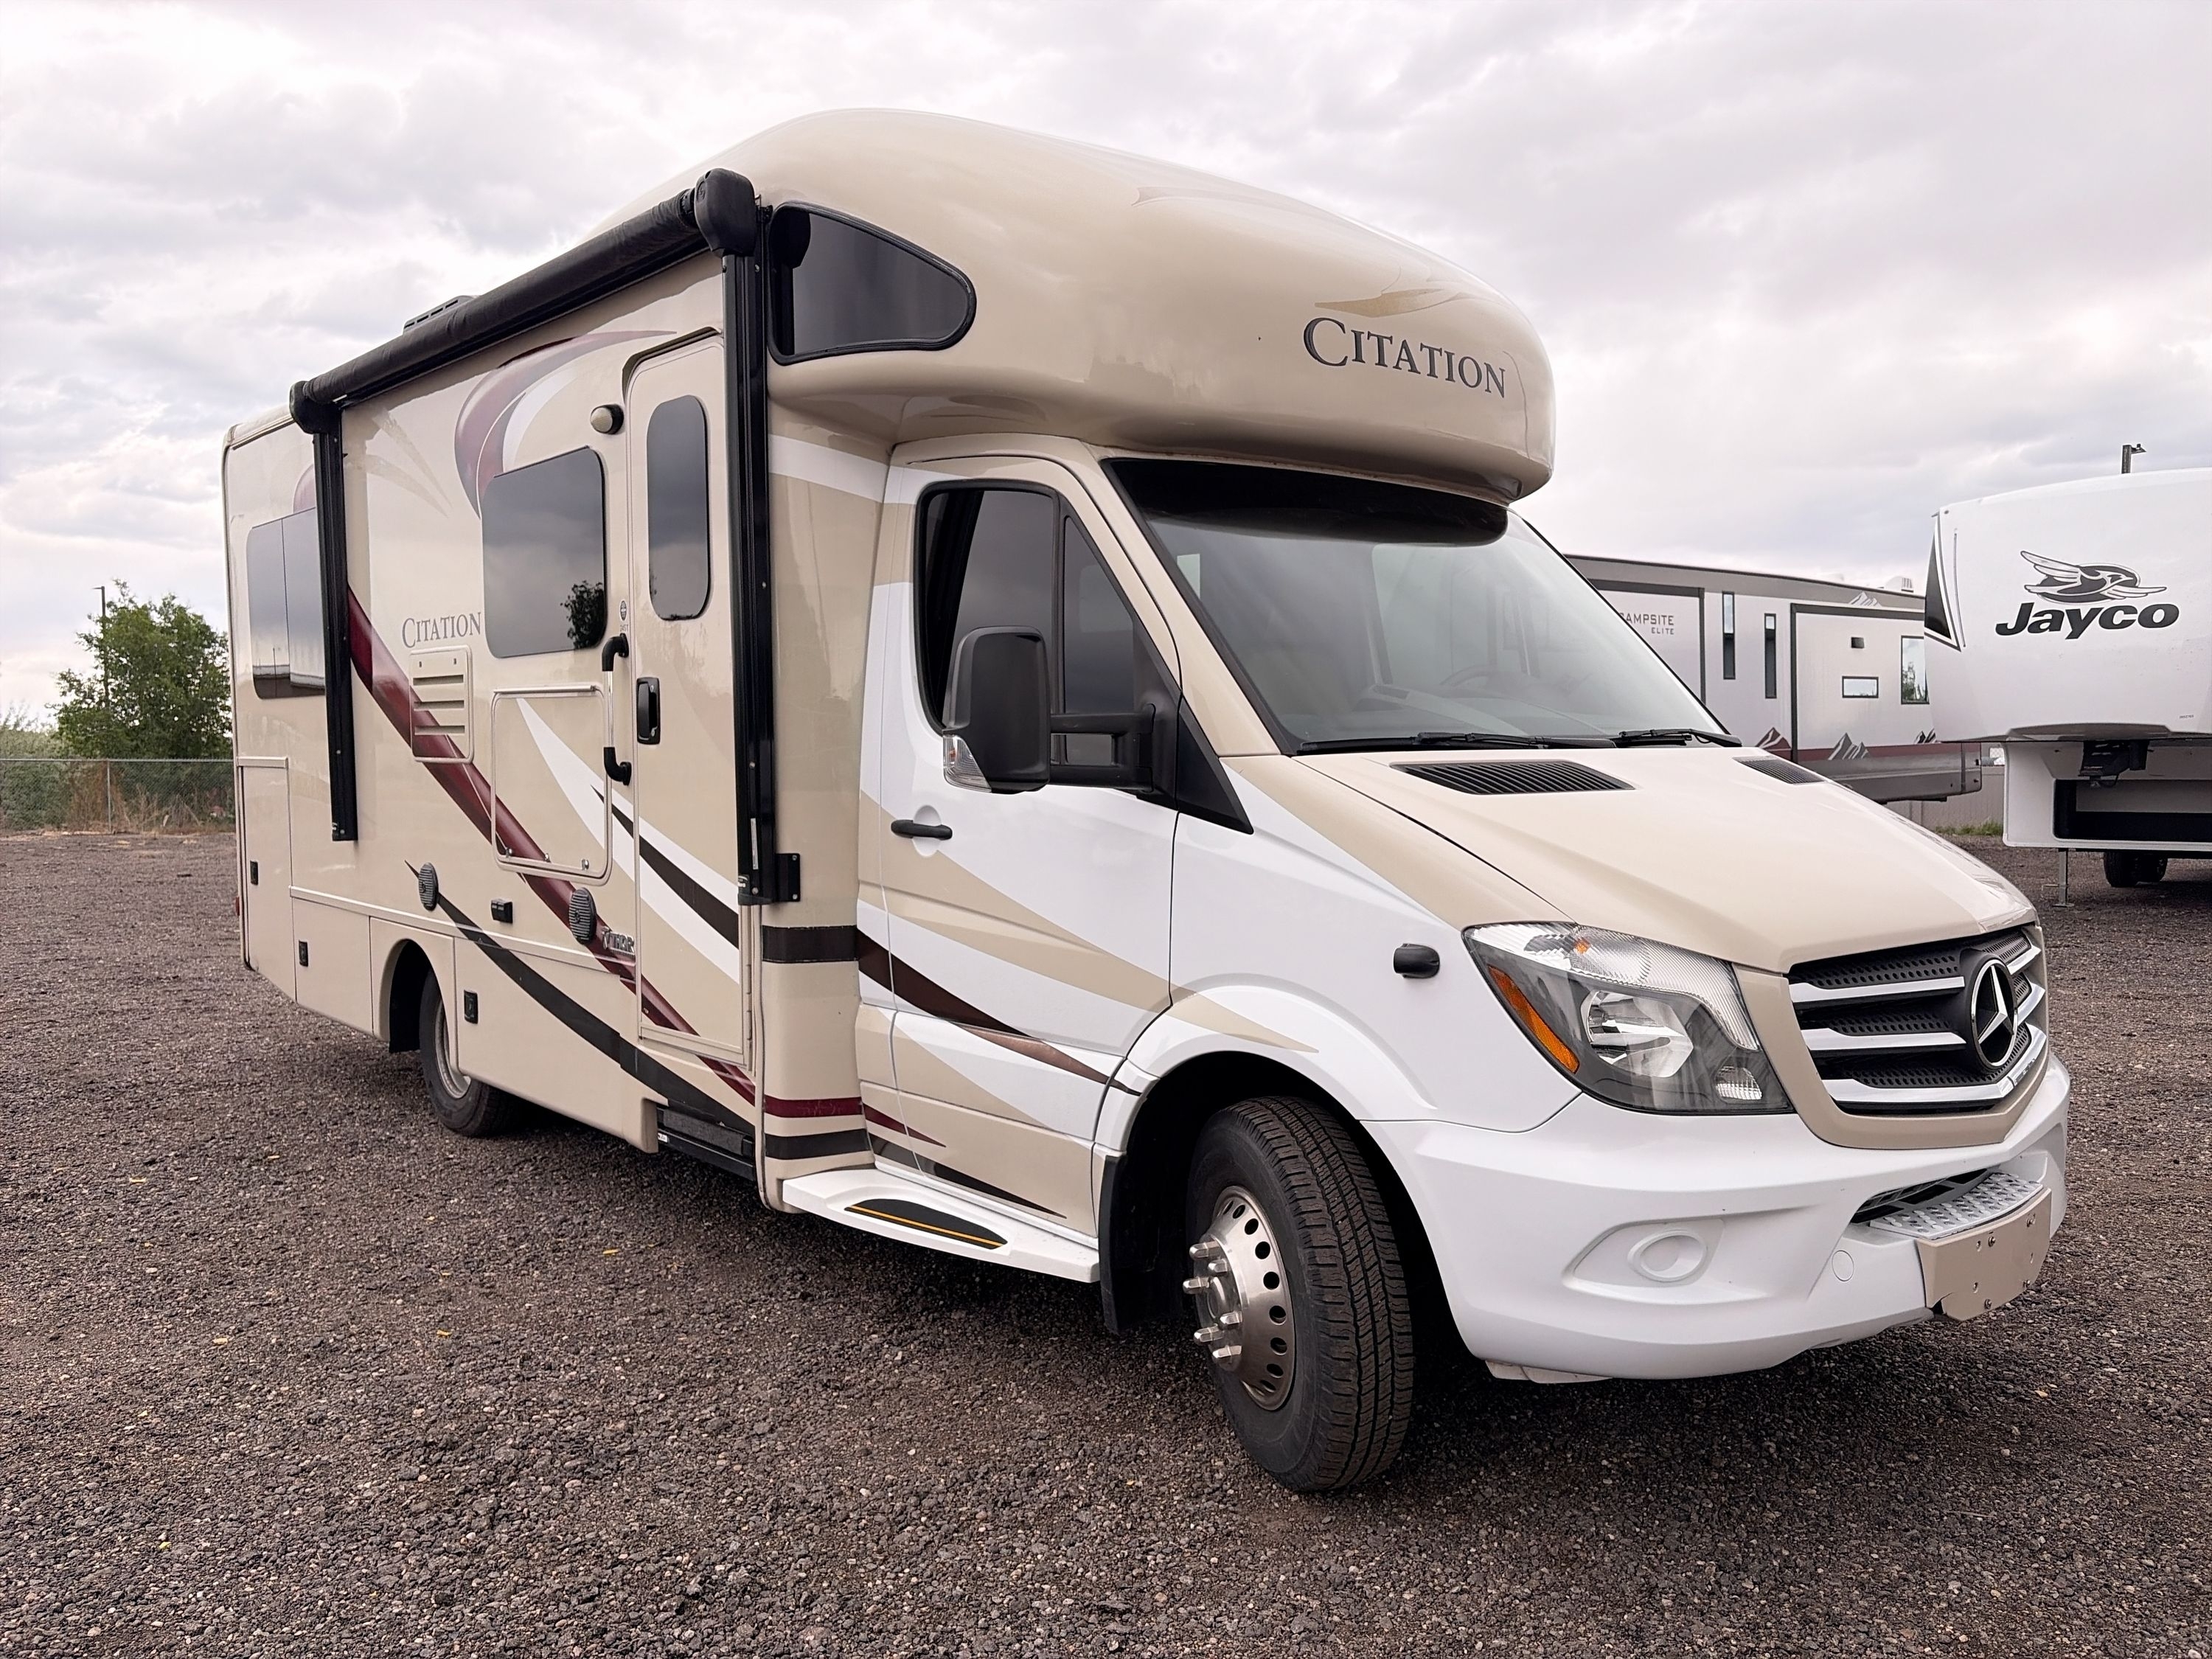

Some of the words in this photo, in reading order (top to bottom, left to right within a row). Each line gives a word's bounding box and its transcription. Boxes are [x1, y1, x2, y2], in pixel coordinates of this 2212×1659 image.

[1303, 317, 1506, 398] CITATION
[403, 613, 481, 649] CITATION
[1651, 627, 1674, 636] ELITE
[1995, 602, 2180, 640] Jayco
